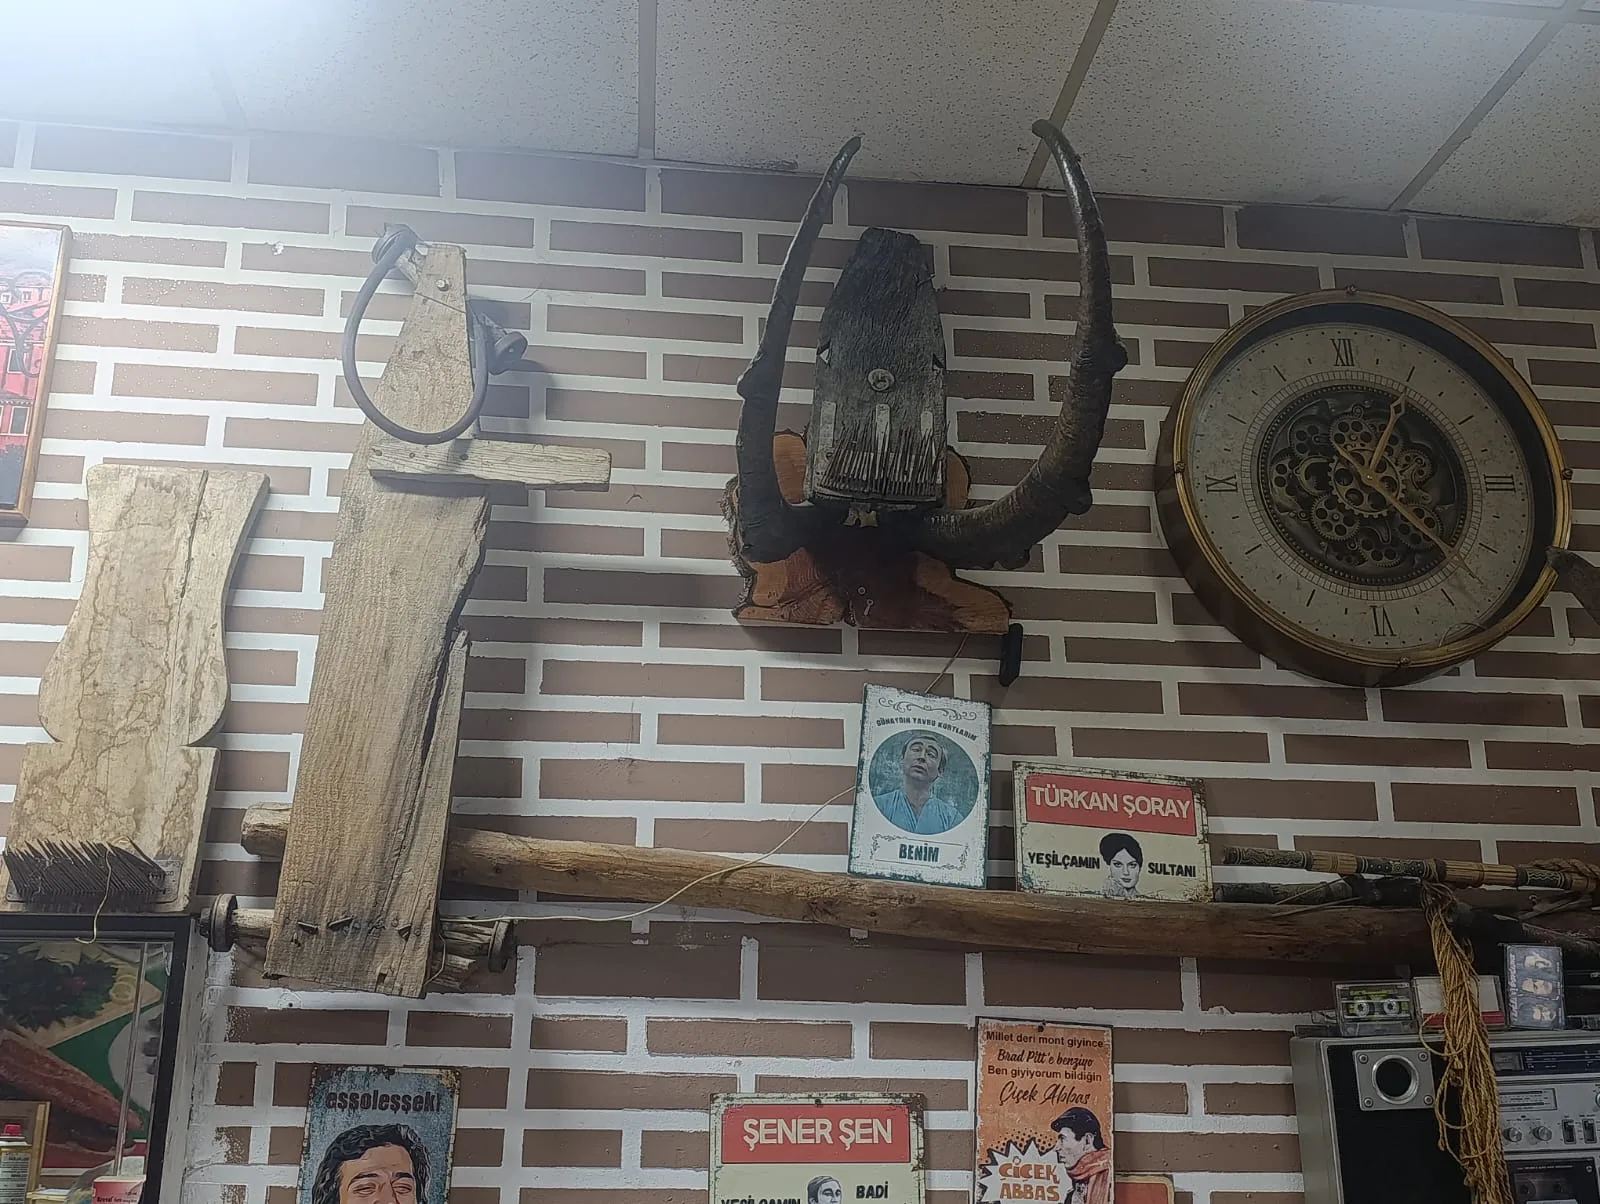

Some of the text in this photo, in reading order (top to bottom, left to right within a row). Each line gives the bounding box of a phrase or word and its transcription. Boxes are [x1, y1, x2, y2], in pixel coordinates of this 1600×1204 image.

[1031, 784, 1191, 819] TÜRKAN ŞORAY
[898, 842, 940, 864] BENİM
[1027, 850, 1197, 878] YEŞİLÇAMIN SULTANI
[986, 1031, 1104, 1049] Millet deri mont giyince
[997, 1048, 1095, 1071] Brad Pitt'e benziyo
[987, 1064, 1102, 1083] Ben giyiyorum bildiğin
[999, 1080, 1092, 1107] Çiçek Abbas
[743, 1118, 892, 1152] ŞENER ŞEN
[856, 1181, 889, 1199] BADİ
[999, 1182, 1061, 1202] ABBAS
